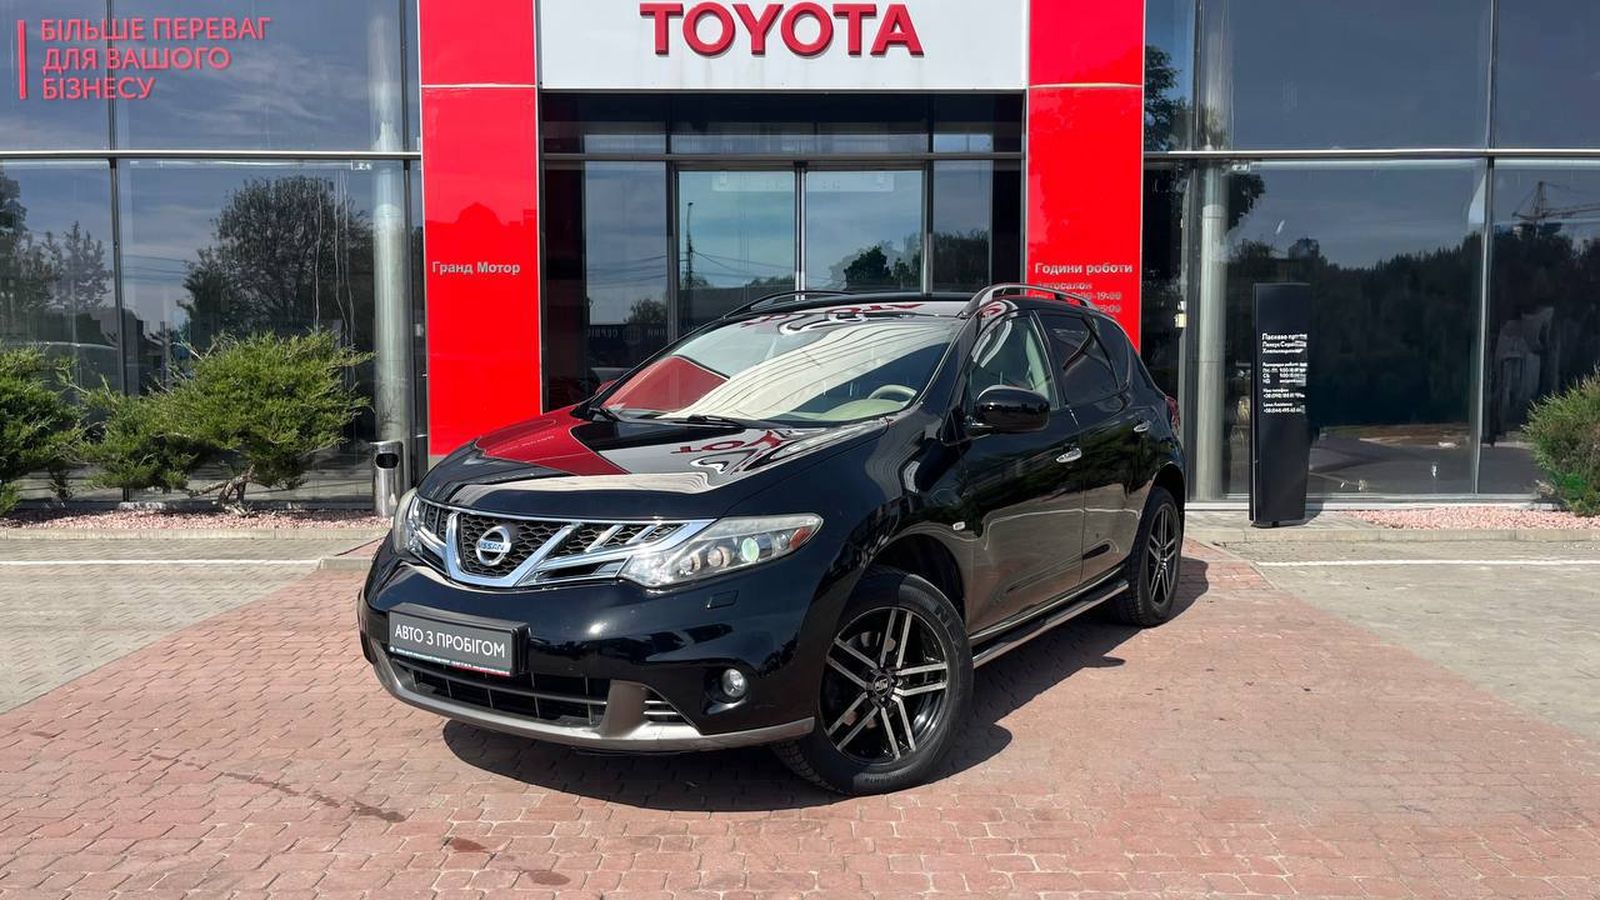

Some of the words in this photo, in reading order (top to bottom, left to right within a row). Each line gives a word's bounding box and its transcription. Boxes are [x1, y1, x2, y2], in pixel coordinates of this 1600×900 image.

[41, 18, 144, 41] БІЛЬШЕ
[153, 17, 271, 41] ПЕРЕВАГ
[639, 3, 925, 57] TOYOTA
[42, 48, 98, 75] ДЛЯ
[106, 47, 231, 70] ВАШОГО
[42, 77, 156, 100] БІЗНЕСУ
[432, 261, 473, 276] Гранд
[477, 261, 520, 276] Мотор
[1035, 262, 1082, 275] Години
[1086, 262, 1133, 276] роботи
[394, 624, 424, 644] АВТО
[426, 630, 434, 646] З
[436, 631, 505, 659] ПРОБІГОМ
